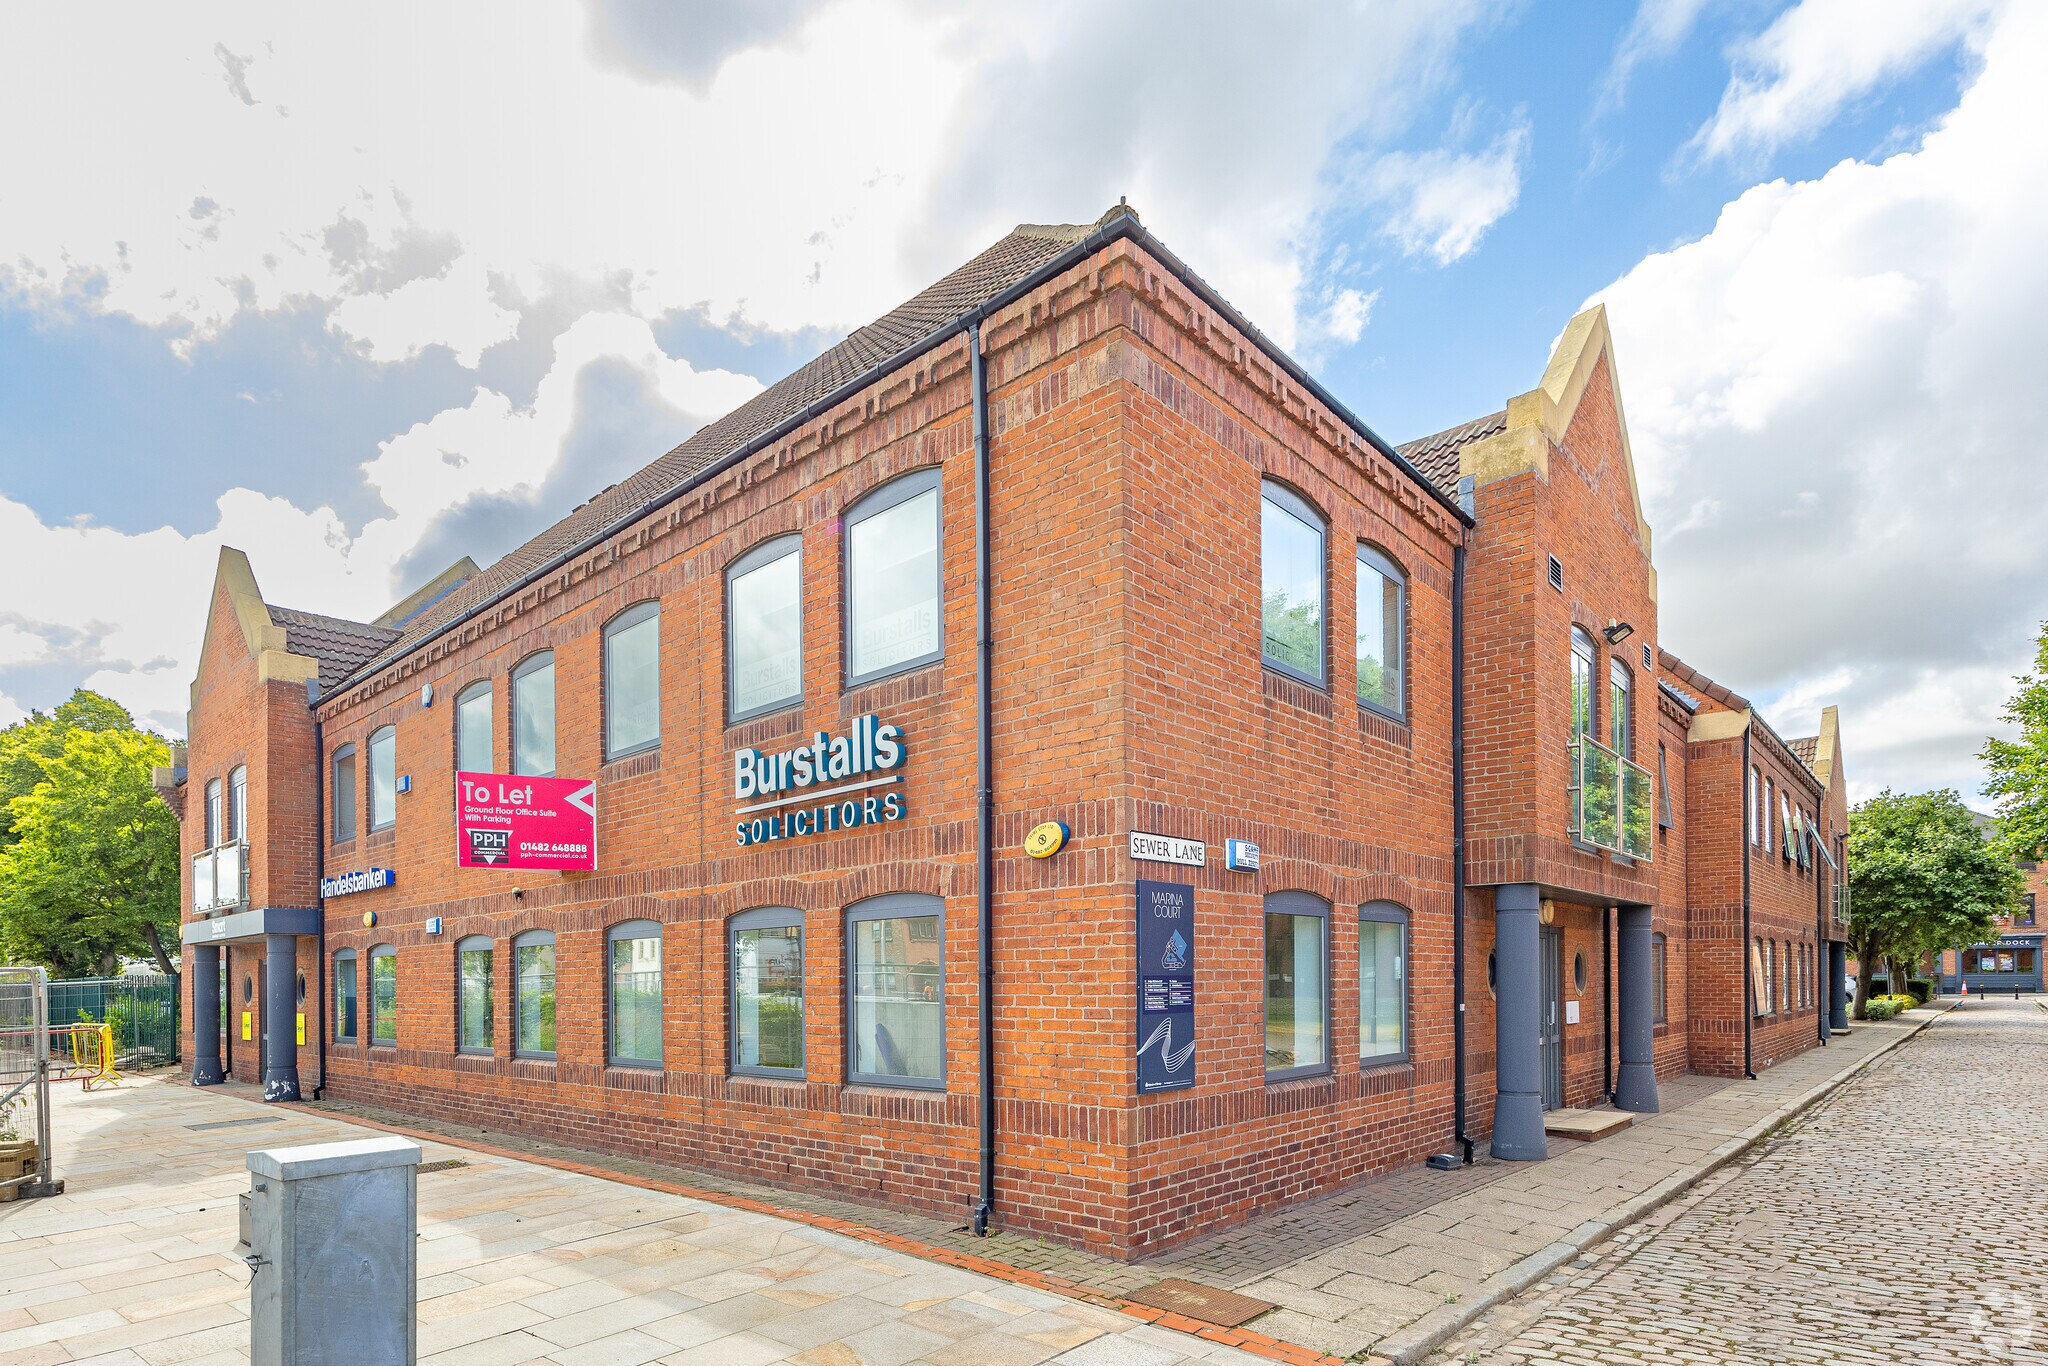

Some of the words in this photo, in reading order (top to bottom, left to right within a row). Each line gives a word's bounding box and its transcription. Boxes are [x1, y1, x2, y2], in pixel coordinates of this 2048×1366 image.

[863, 608, 931, 648] Burstalls
[742, 655, 796, 689] Burstalls
[734, 714, 904, 799] Burstalls
[462, 781, 490, 803] To
[498, 783, 533, 805] Let
[464, 805, 494, 814] Ground
[495, 807, 514, 815] Floor
[515, 808, 538, 817] Office
[539, 809, 557, 817] Suite
[464, 813, 482, 822] With
[482, 814, 512, 824] Parking
[736, 792, 904, 846] SOLICITORS
[473, 833, 506, 847] PPH
[520, 842, 550, 852] 01482
[551, 843, 588, 853] 648888
[1133, 837, 1171, 857] SEWER
[1175, 843, 1203, 862] LANE
[320, 867, 387, 899] Handelsbanken
[1151, 891, 1184, 906] MARINA
[1154, 905, 1182, 919] COURT
